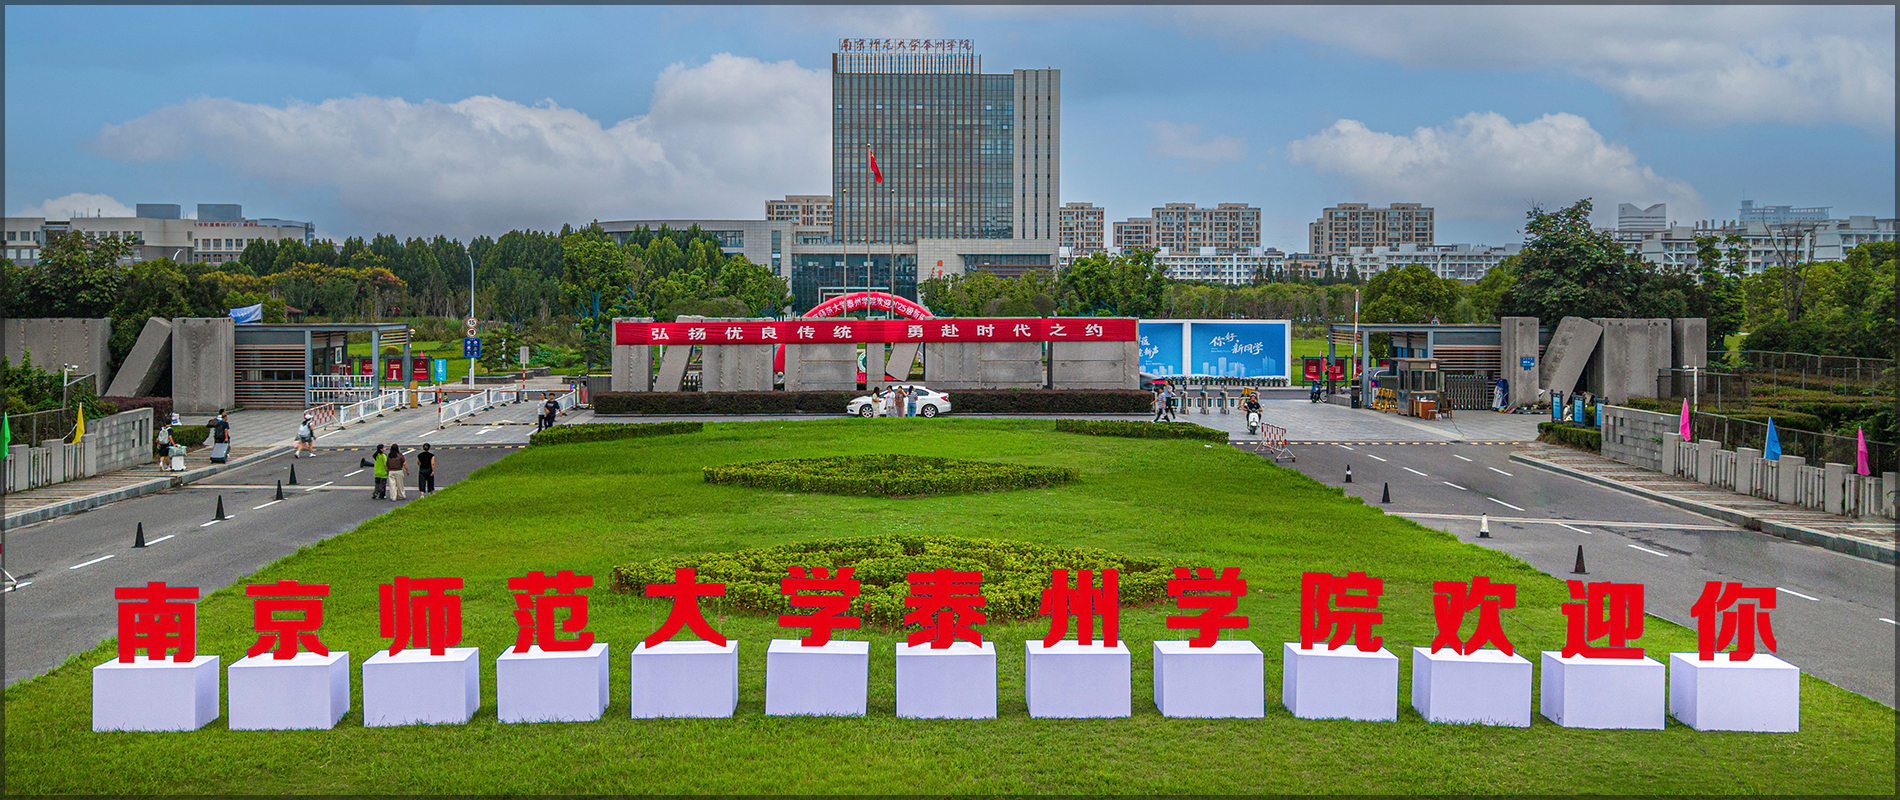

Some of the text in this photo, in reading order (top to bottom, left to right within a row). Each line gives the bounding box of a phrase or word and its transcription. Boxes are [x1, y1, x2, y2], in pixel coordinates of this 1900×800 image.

[651, 322, 1103, 340] 弘扬优良传统 勇赴时代之约
[1231, 341, 1264, 355] 新同学
[114, 566, 1778, 663] 南京师范大学泰州学院欢迎你
